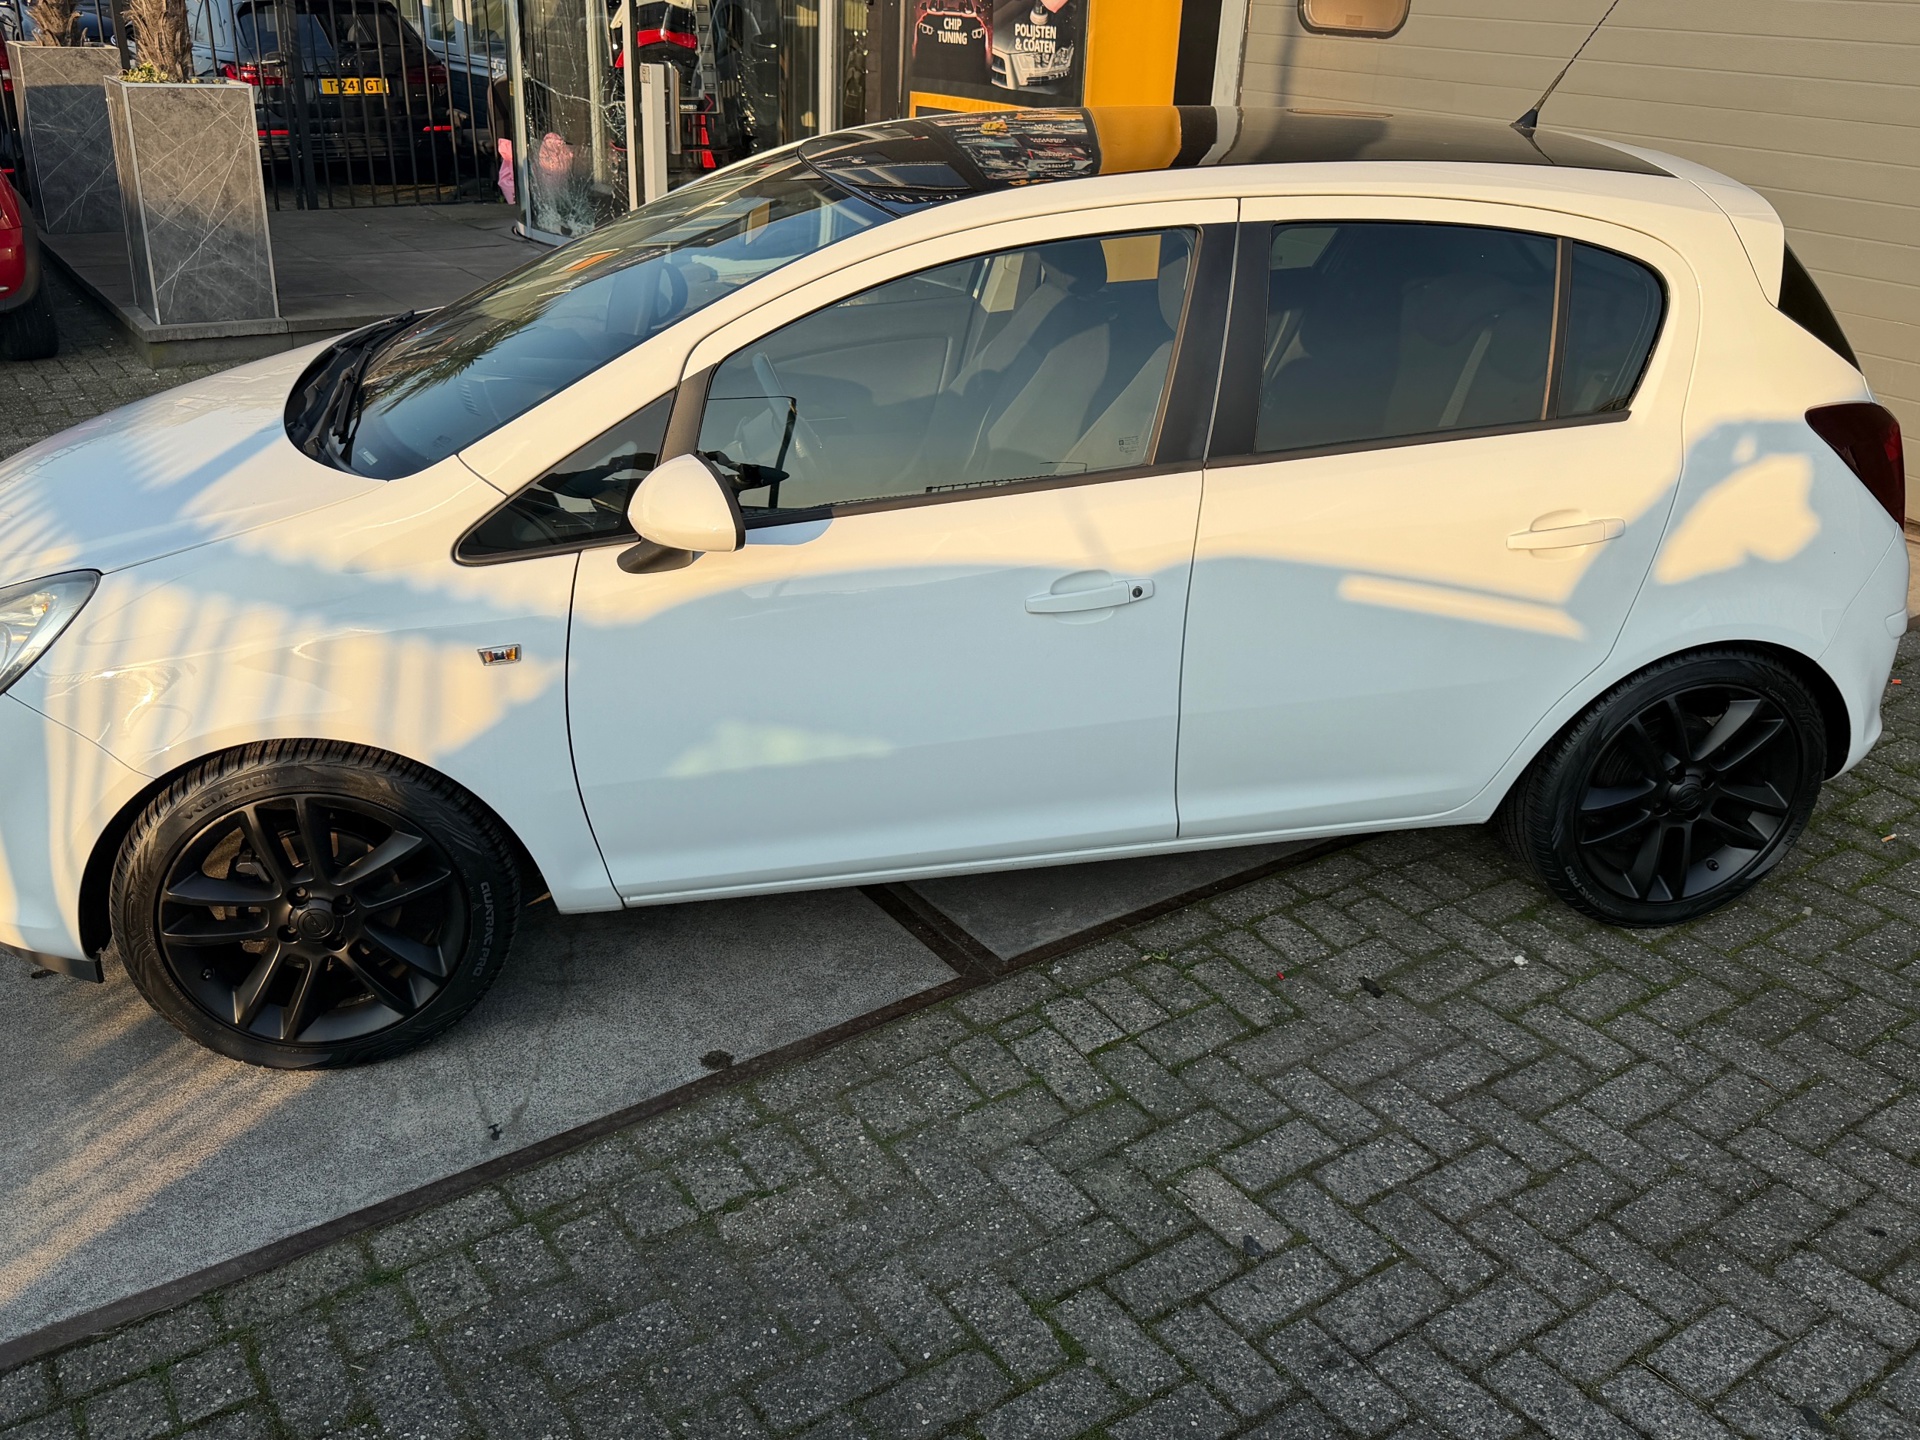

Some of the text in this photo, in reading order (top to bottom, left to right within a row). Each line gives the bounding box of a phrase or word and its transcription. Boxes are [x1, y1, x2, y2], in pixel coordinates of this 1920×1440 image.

[943, 17, 963, 31] CHIP
[1014, 23, 1057, 40] POLIJSTEN
[937, 30, 968, 45] TUNING
[1023, 39, 1056, 54] COATEN
[472, 948, 491, 976] PRO
